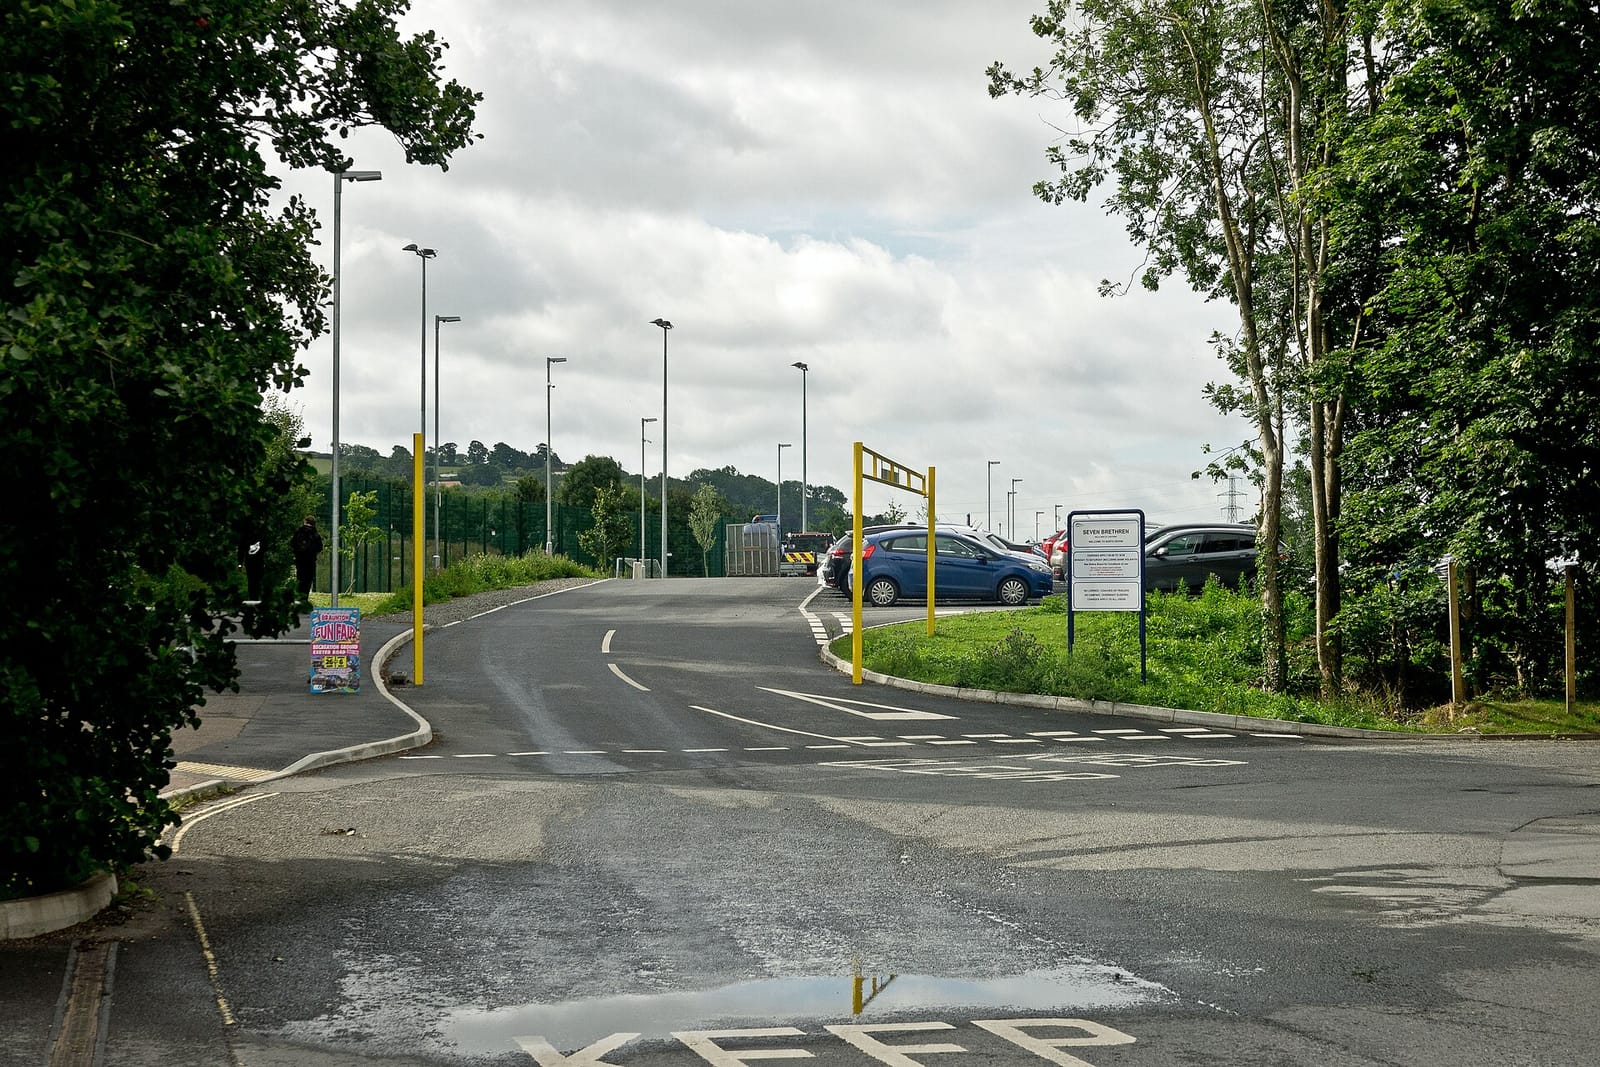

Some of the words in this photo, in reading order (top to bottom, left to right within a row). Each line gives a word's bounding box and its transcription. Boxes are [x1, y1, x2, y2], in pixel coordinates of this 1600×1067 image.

[315, 624, 333, 641] FUN
[335, 624, 355, 641] FAIR
[998, 752, 1249, 768] KEEP
[818, 758, 1121, 783] CLEAR
